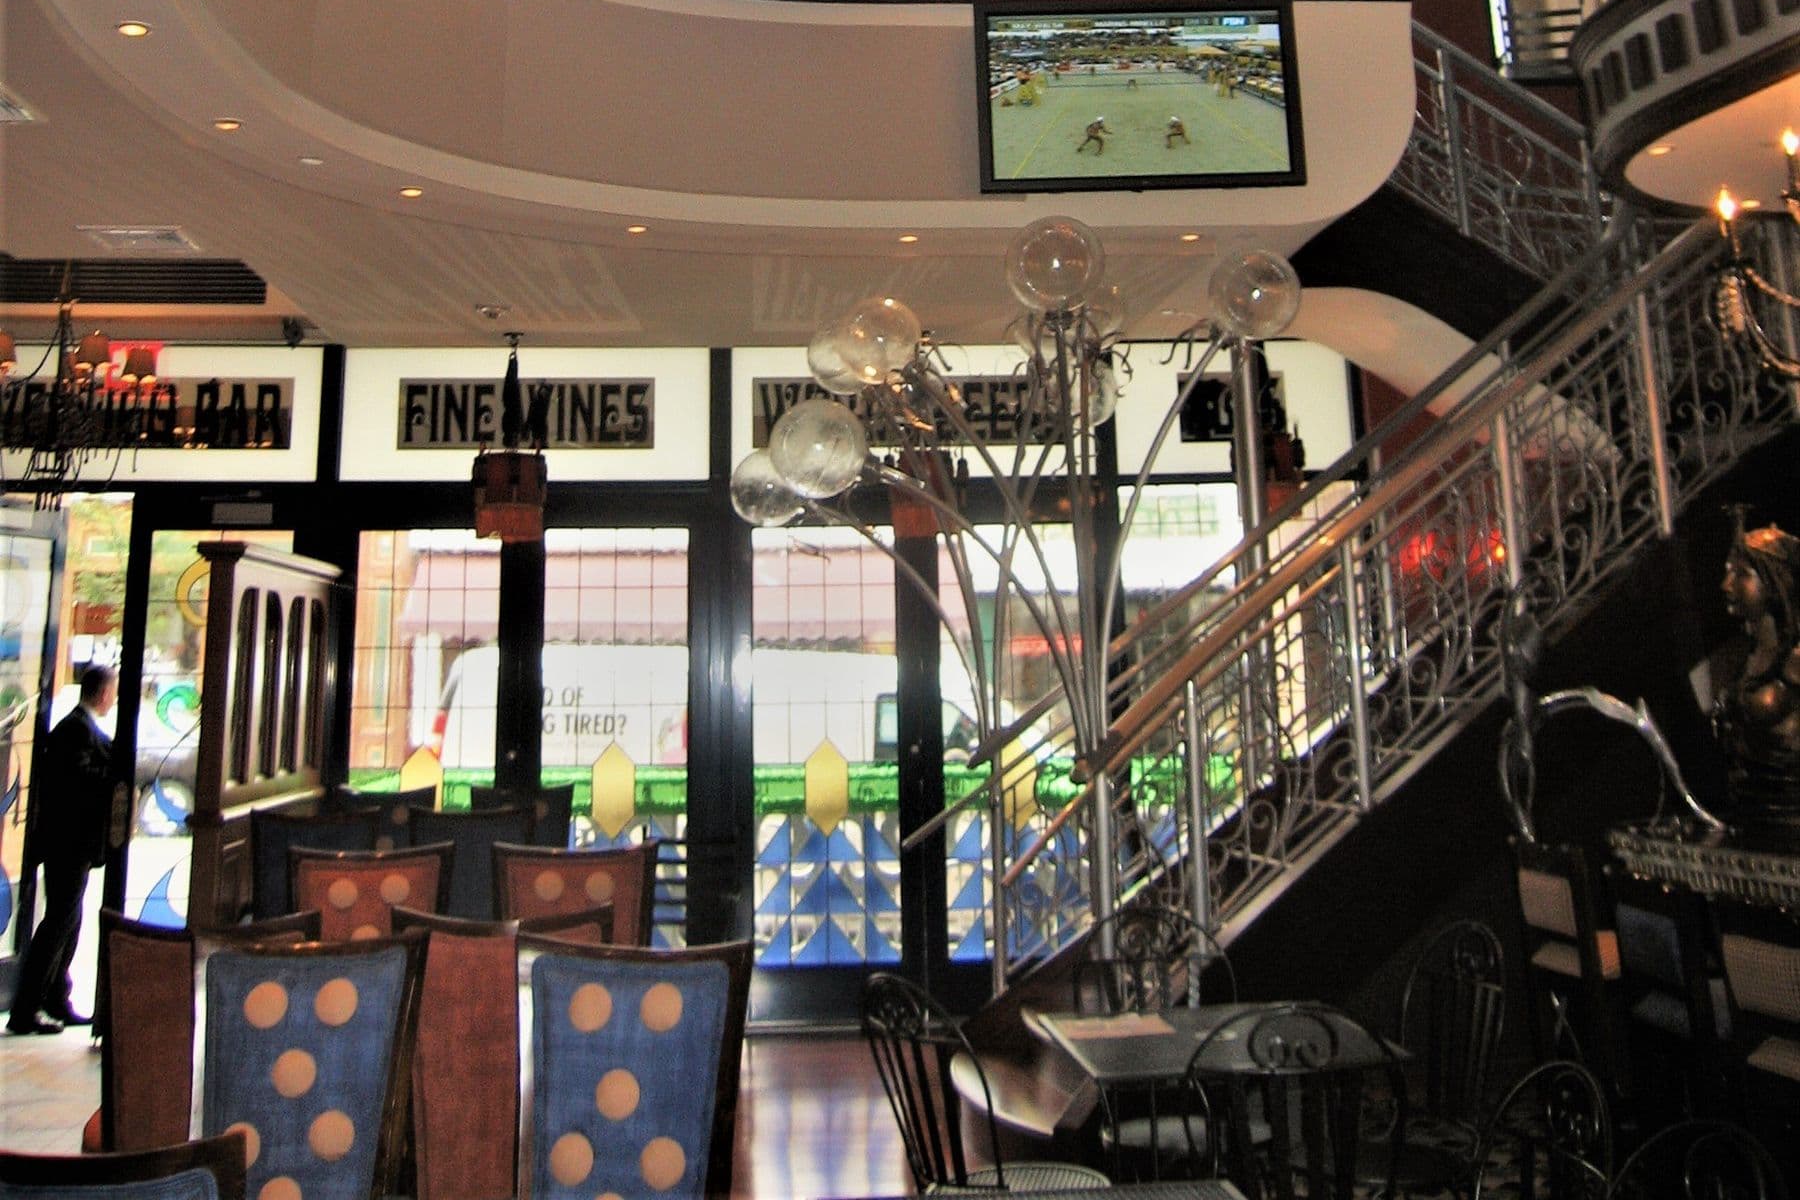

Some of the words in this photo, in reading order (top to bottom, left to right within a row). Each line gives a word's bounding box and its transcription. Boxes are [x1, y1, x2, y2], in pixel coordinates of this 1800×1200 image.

[404, 383, 497, 443] FINE
[561, 686, 584, 707] OF
[564, 713, 628, 736] TIRED?
